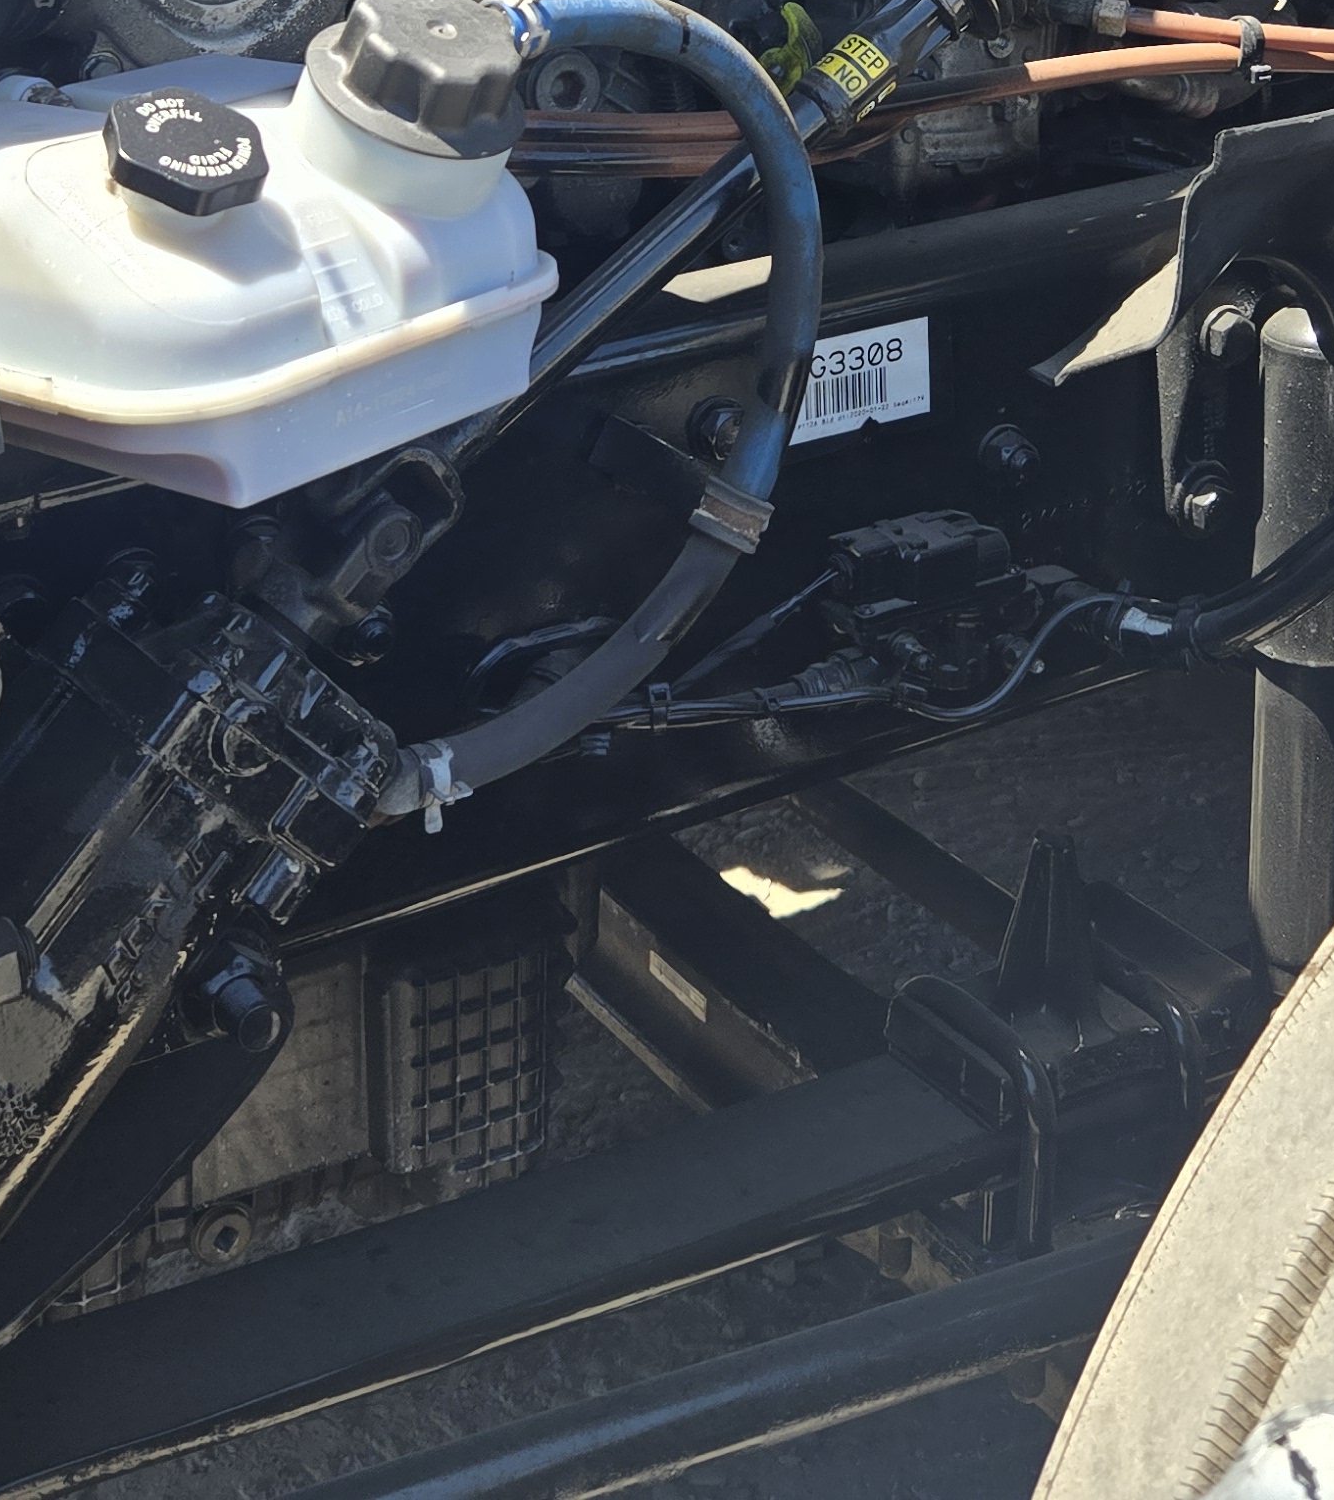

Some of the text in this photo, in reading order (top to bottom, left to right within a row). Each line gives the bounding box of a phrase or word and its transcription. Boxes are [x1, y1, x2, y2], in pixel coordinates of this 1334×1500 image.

[841, 36, 884, 74] STEP
[834, 64, 862, 93] NO
[135, 97, 185, 117] DO NOT
[145, 108, 203, 133] OVERFILL
[158, 136, 252, 177] POWER STEERING
[189, 146, 234, 166] FLUID
[810, 337, 903, 379] G3308
